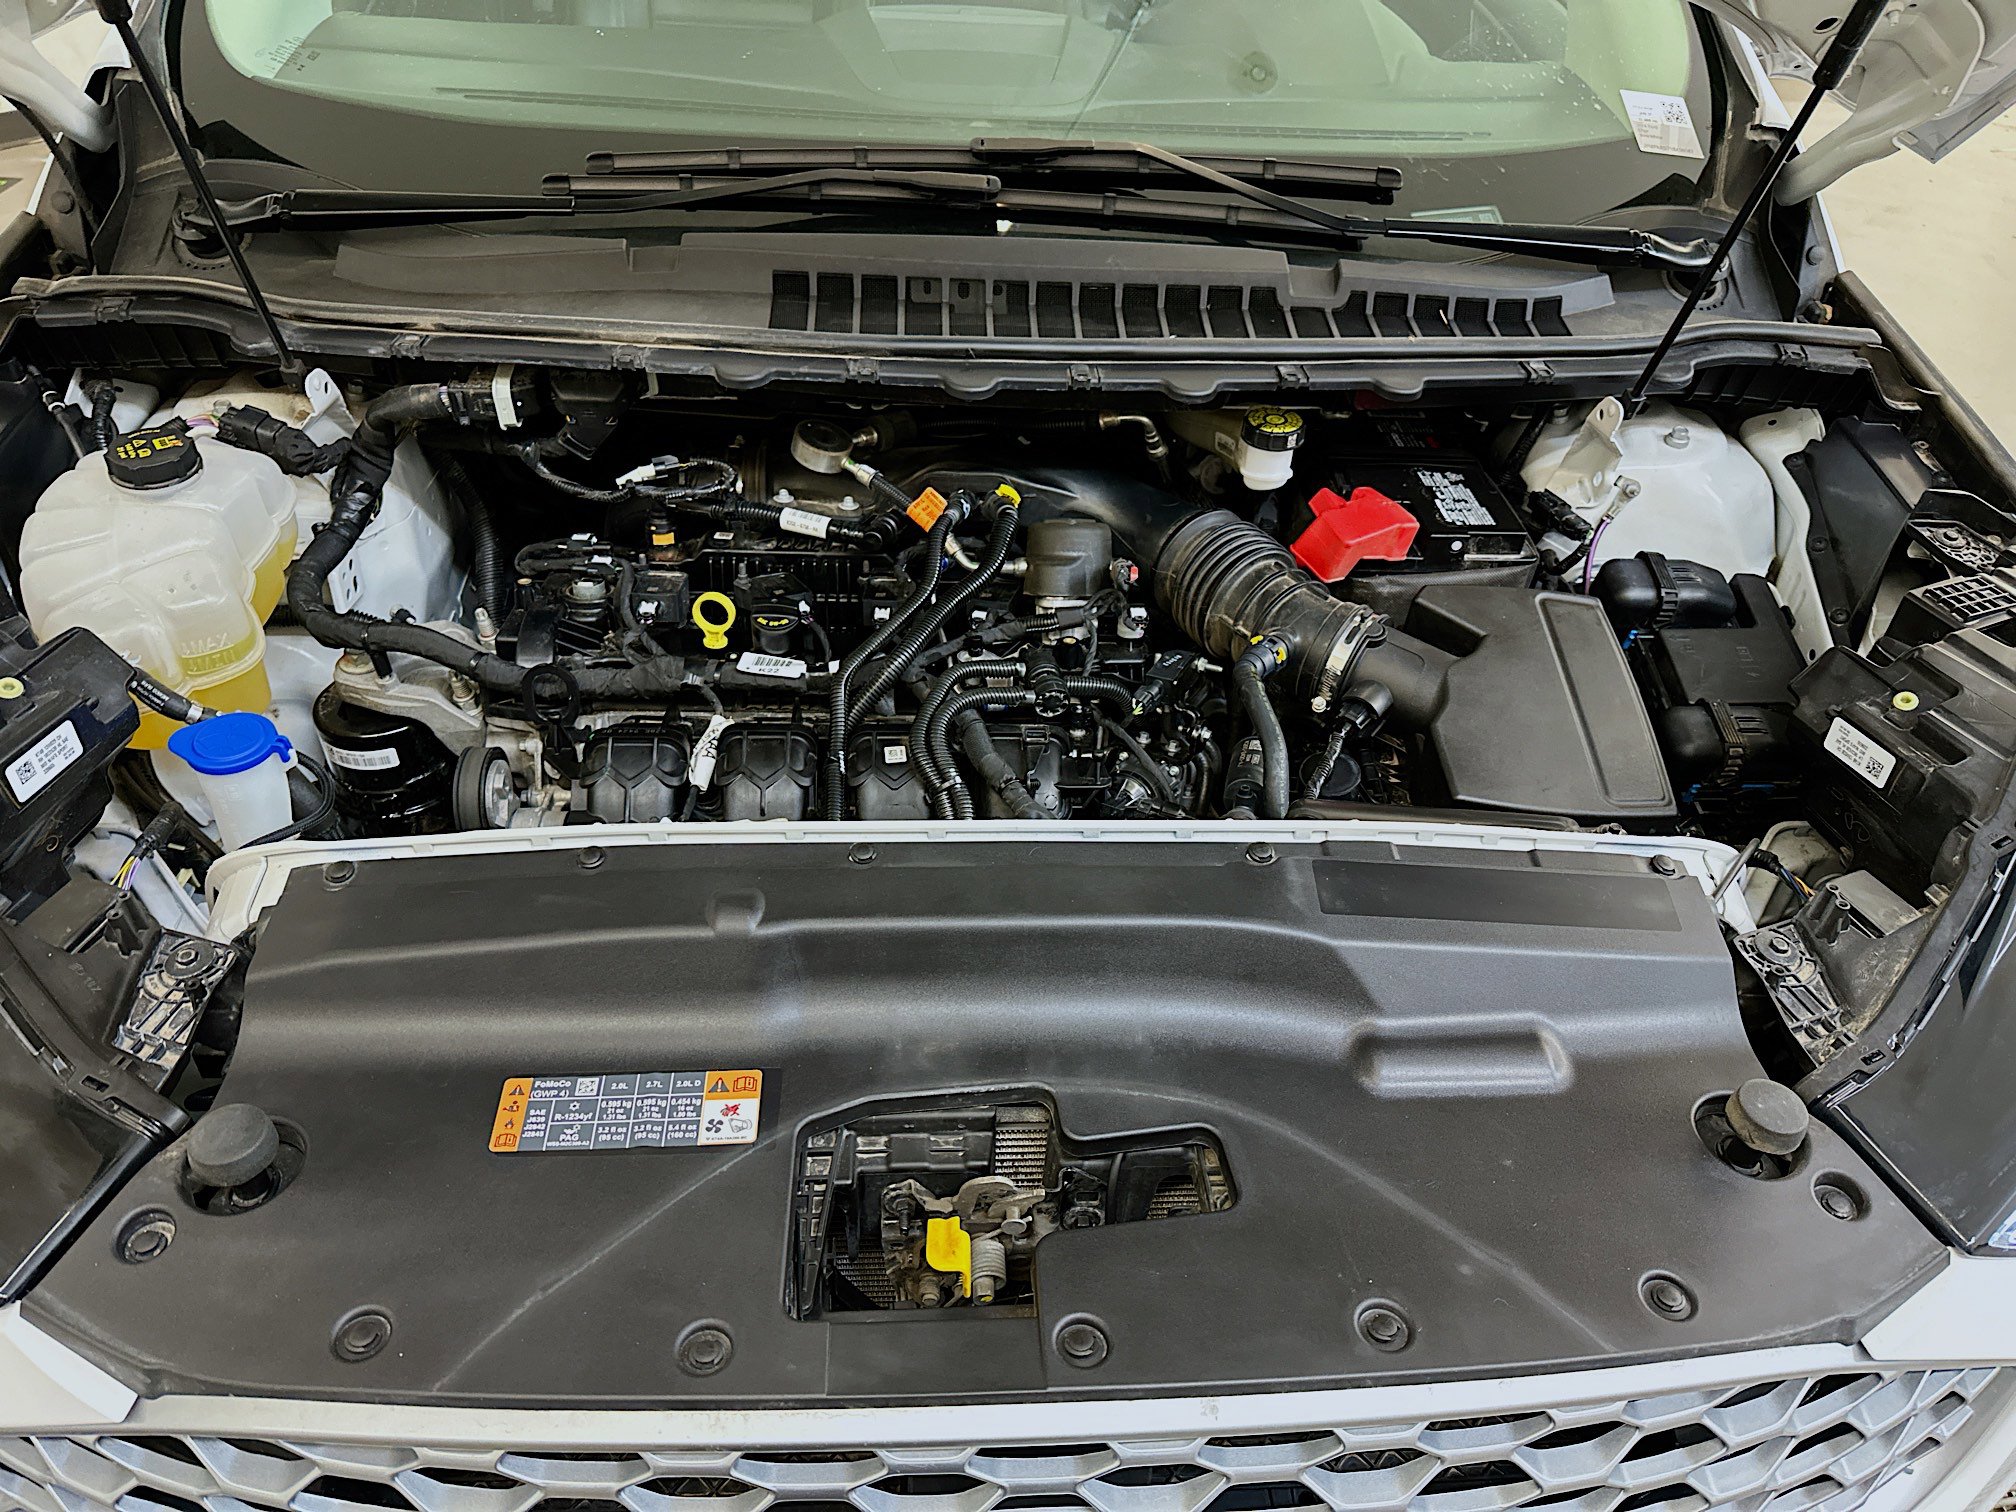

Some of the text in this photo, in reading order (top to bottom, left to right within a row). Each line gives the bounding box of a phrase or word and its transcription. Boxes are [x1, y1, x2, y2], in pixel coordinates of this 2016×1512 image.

[531, 1090, 557, 1098] (GWP
[657, 1099, 666, 1107] kg
[554, 1113, 593, 1122] R-1234yf
